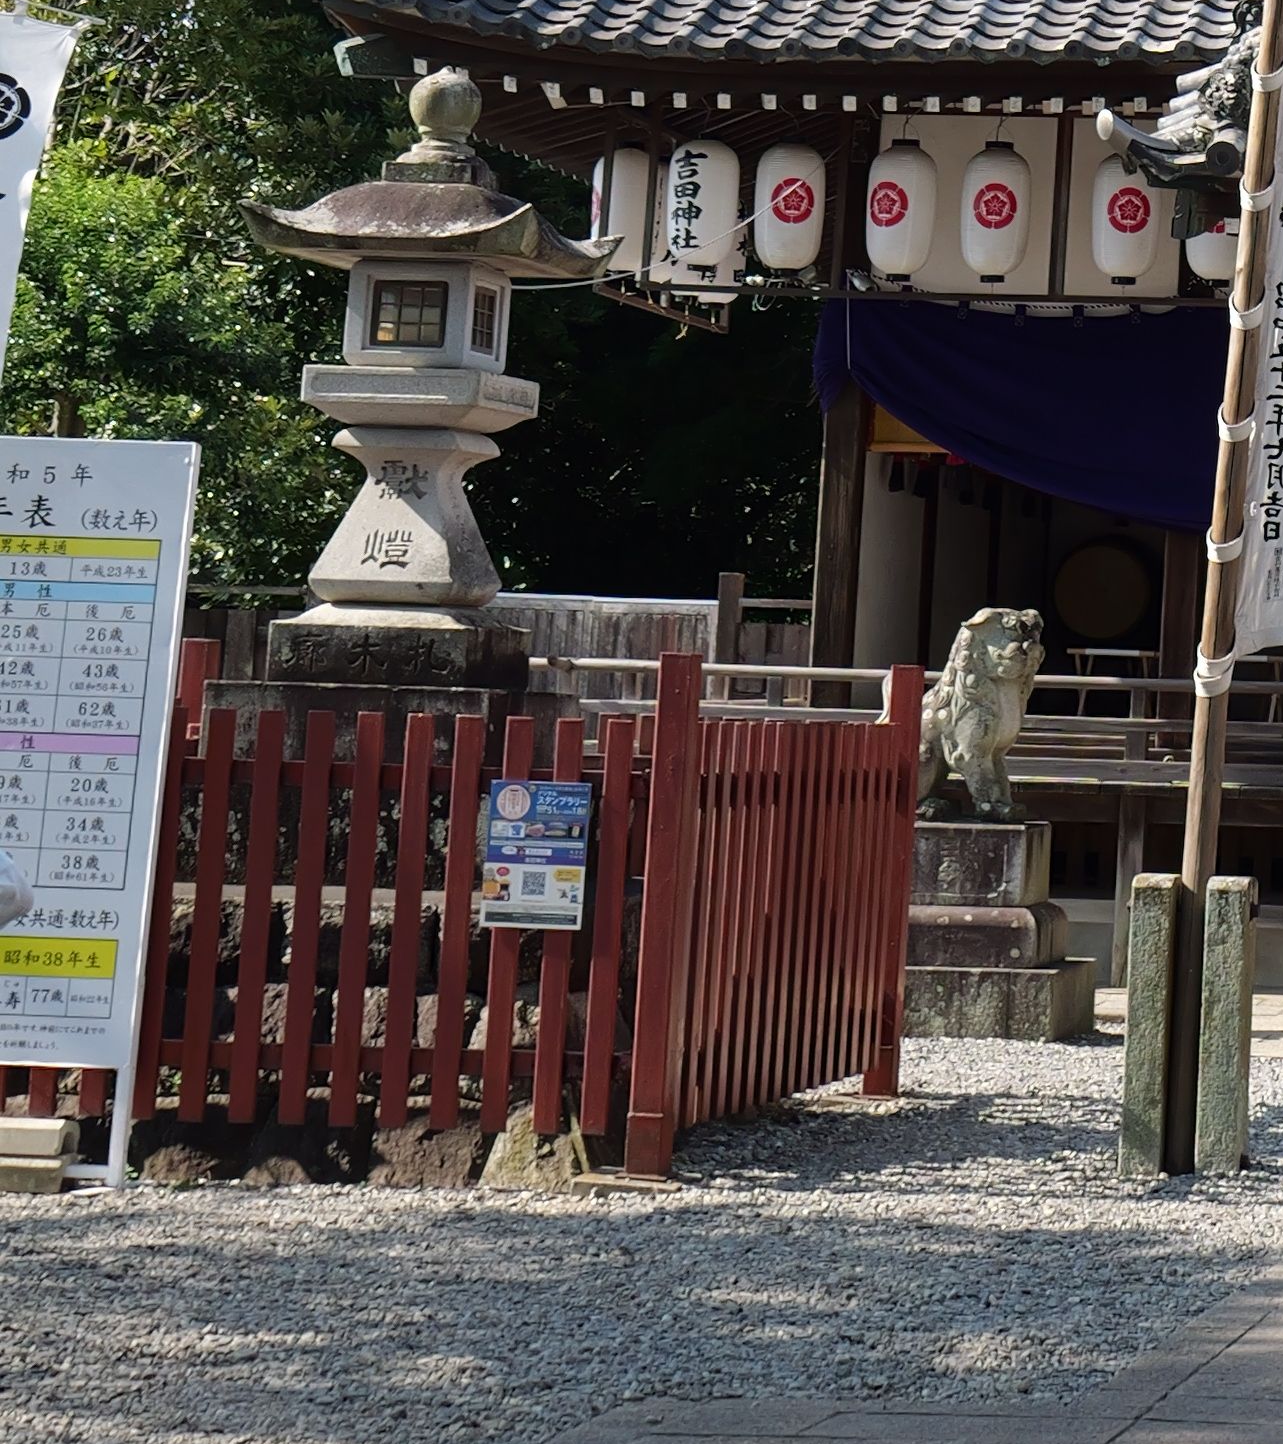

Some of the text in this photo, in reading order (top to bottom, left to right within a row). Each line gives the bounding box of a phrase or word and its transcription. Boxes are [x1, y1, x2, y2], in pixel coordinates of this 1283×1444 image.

[671, 149, 708, 249] 吉田神社
[81, 508, 158, 533] (数え年)
[1, 538, 67, 555] 男女共通
[10, 561, 47, 577] 13歳
[80, 565, 148, 579] 平成23年生
[1, 624, 39, 640] 25歳
[86, 627, 124, 644] 26歳
[82, 664, 120, 679] 43歳
[0, 698, 30, 714] 1歳
[78, 701, 117, 718] 62歳
[70, 777, 109, 794] 20歳
[65, 816, 105, 833] 34歳
[0, 831, 30, 842] 年生)
[61, 854, 100, 871] 38歳
[4, 949, 101, 970] 昭和38年生
[31, 989, 64, 1004] 77歳
